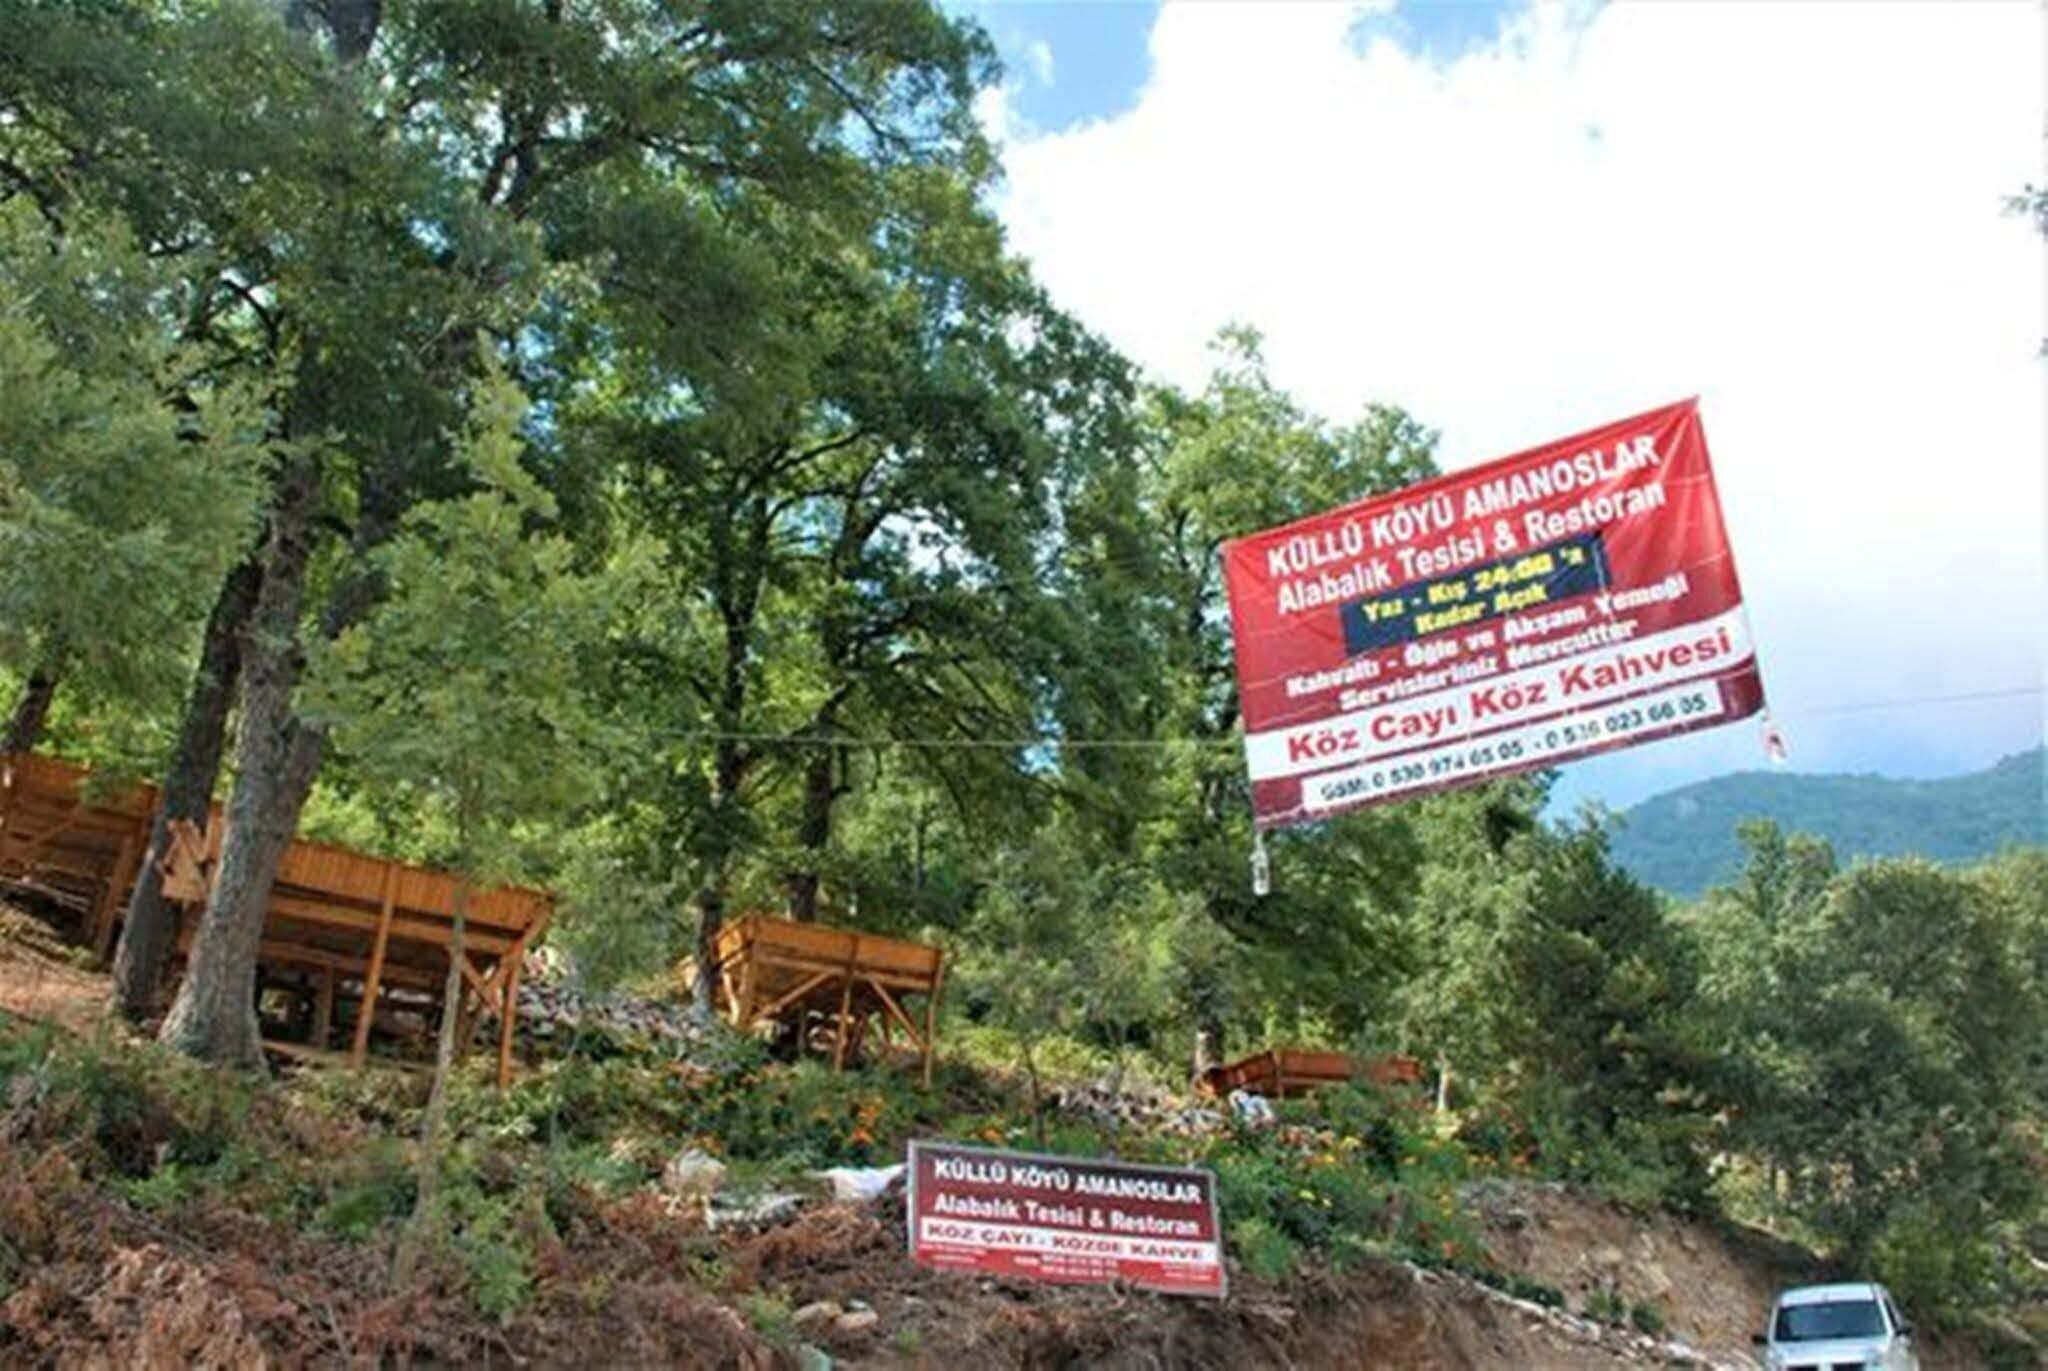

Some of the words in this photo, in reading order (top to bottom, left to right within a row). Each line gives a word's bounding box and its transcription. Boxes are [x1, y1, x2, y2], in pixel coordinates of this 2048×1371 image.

[1268, 518, 1363, 577] KÜLLÜ
[1371, 491, 1454, 548] KÖYÜ
[1464, 435, 1661, 519] AMANOSLAR
[1278, 556, 1391, 614] Alabalık
[1396, 528, 1485, 579] Tesisi
[1493, 520, 1517, 551] &
[1524, 481, 1666, 544] Restoran
[1415, 601, 1486, 634] Kadar
[1466, 629, 1495, 650] ve
[1287, 727, 1360, 763] Köz
[1468, 681, 1548, 718] Köz
[1558, 627, 1733, 695] Kahvesi
[934, 1158, 1006, 1184] KÜLLÜ
[1011, 1165, 1070, 1191] KÖYÜ
[1074, 1174, 1201, 1203] AMANOSLAR
[934, 1193, 1019, 1219] Alabalık
[1024, 1201, 1084, 1226] Tesisi
[1088, 1209, 1105, 1228] &
[1110, 1211, 1200, 1235] Restoran
[1130, 1243, 1203, 1259] KAHVE
